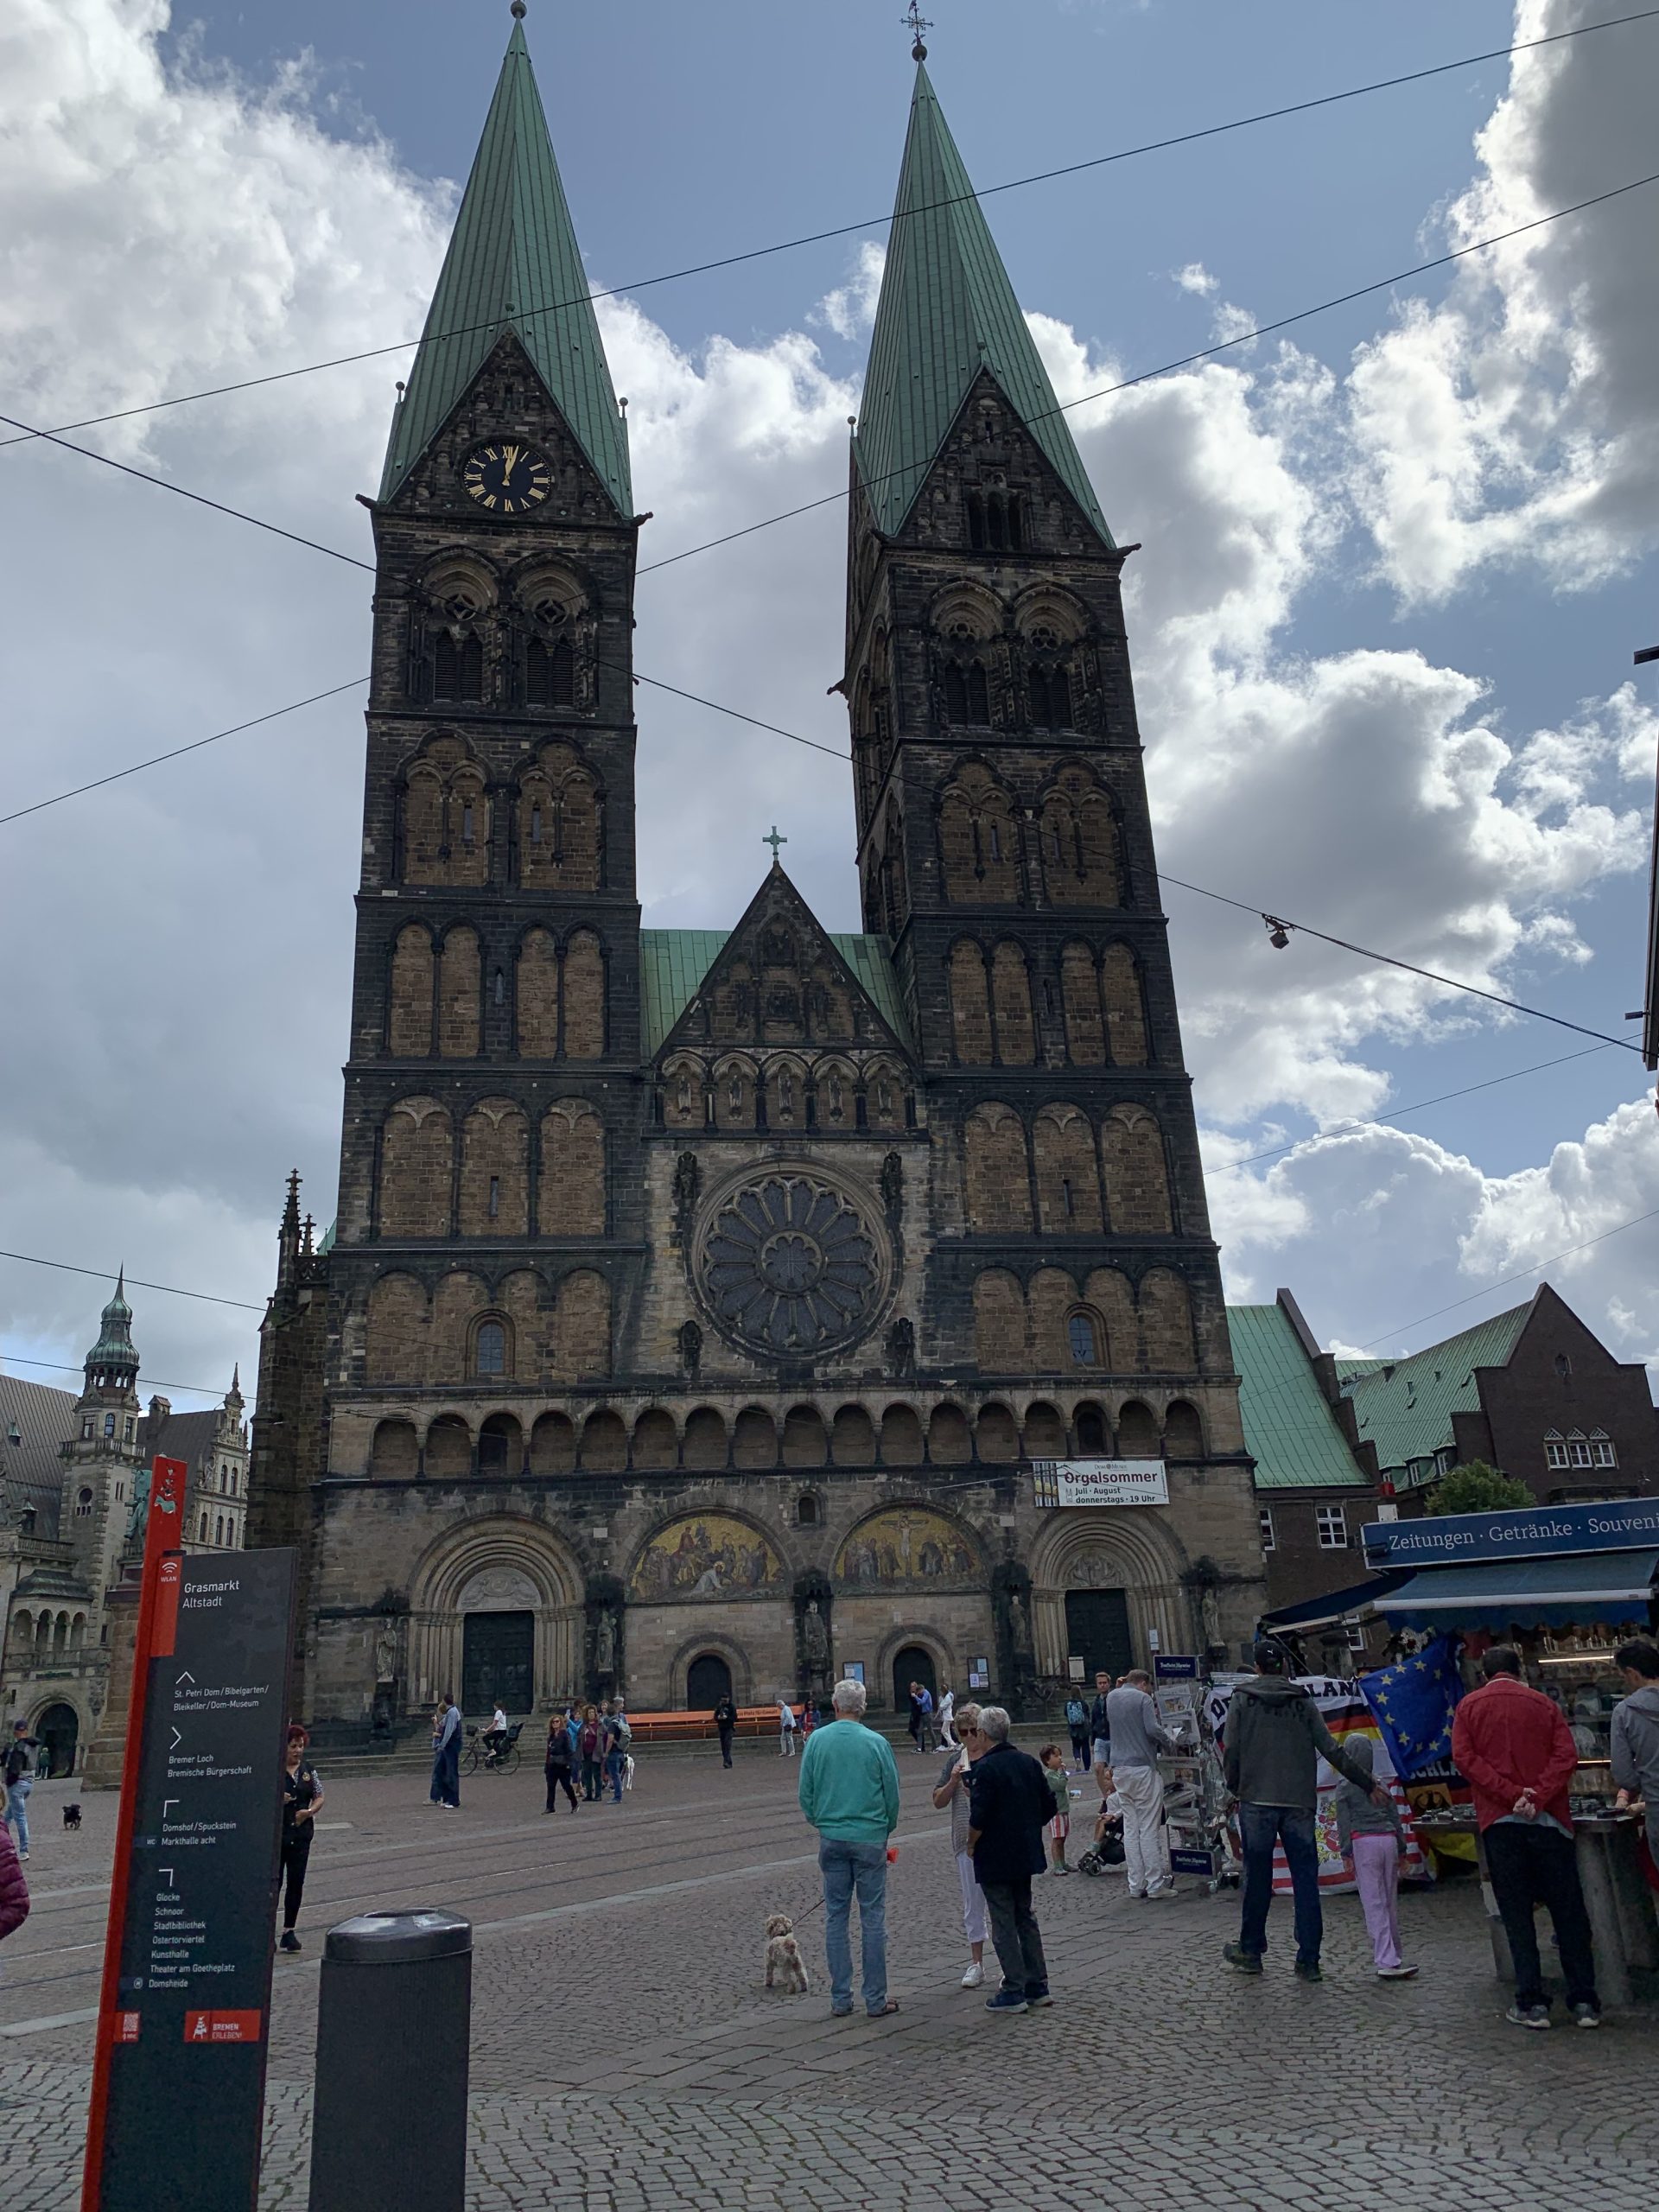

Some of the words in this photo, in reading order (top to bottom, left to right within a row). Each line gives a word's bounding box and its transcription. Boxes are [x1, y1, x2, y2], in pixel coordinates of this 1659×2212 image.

[1065, 1471, 1158, 1486] Orgelsommer
[1075, 1487, 1088, 1497] Juli
[1093, 1487, 1121, 1497] August
[1389, 1532, 1476, 1551] Zeitungen
[1489, 1521, 1573, 1542] Getränke
[184, 1580, 240, 1593] Grasmarkt
[182, 1596, 223, 1609] Altstadt
[185, 1688, 202, 1697] Petri
[168, 1755, 195, 1764] Bremer
[197, 1754, 214, 1763] Loch
[168, 1768, 205, 1777] Bremische
[207, 1765, 252, 1777] Bürgerschaft
[162, 1836, 199, 1846] Markthalle
[200, 1835, 216, 1845] acht
[156, 1893, 181, 1902] Glocke
[155, 1907, 185, 1916] Schnoor
[154, 1921, 207, 1930] Stadtbibliothek
[152, 1936, 205, 1944] Ostertorviertel
[151, 1949, 189, 1959] Kunsthalle
[150, 1964, 177, 1974] Theater
[192, 1963, 235, 1974] Goetheplatz
[149, 1979, 188, 1988] Domsheide
